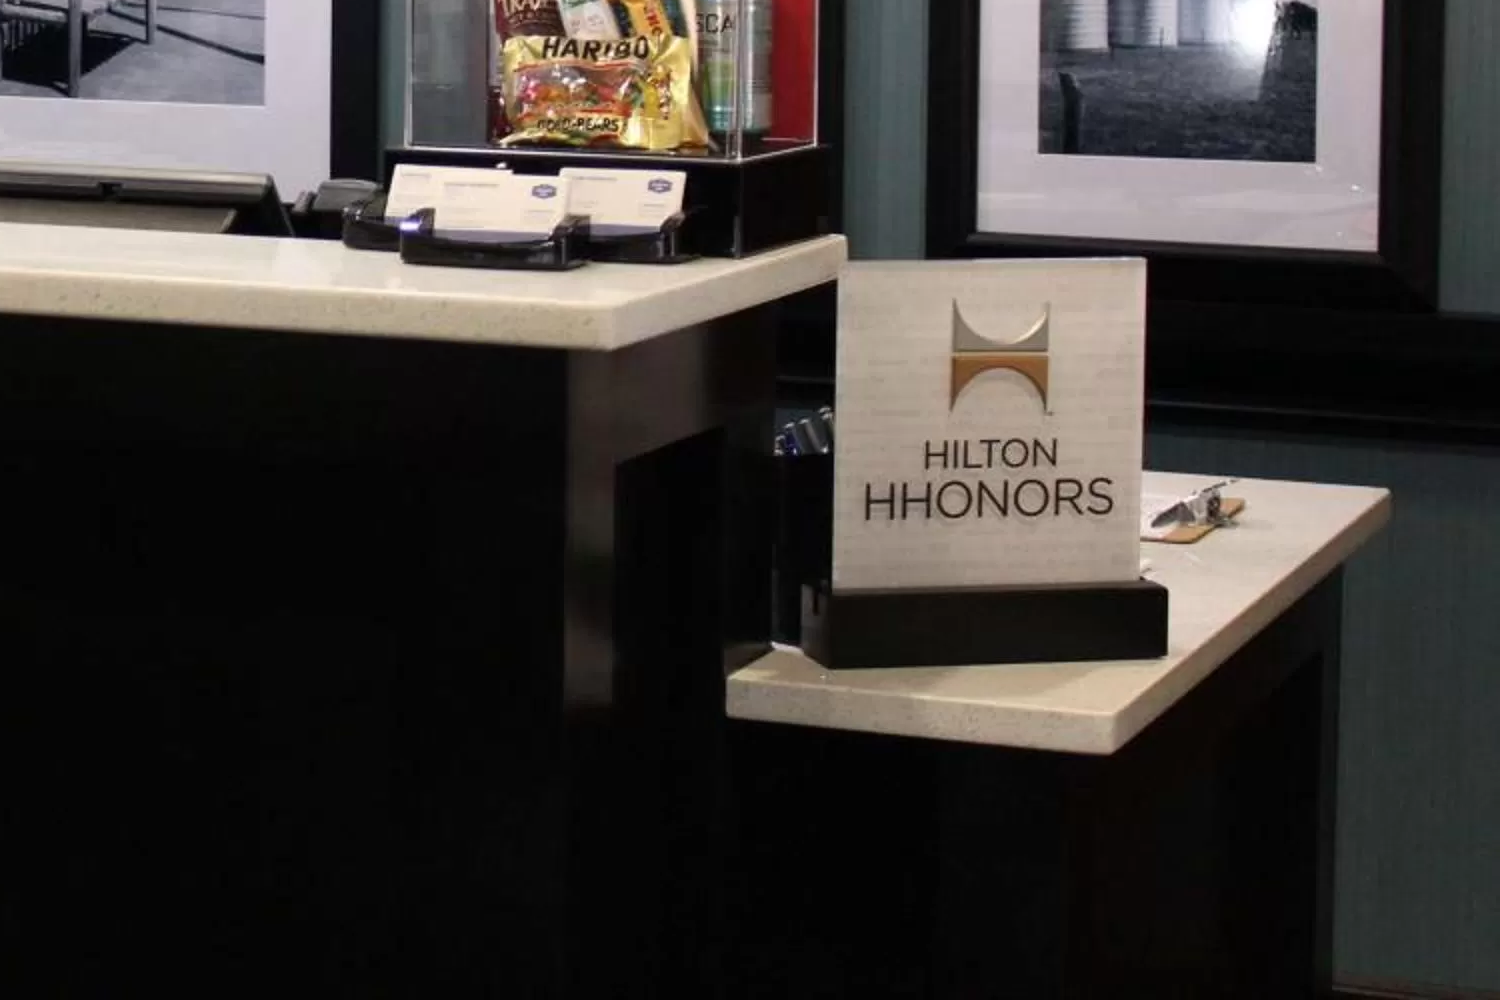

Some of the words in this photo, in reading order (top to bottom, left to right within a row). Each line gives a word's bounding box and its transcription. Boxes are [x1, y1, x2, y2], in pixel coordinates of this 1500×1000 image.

[542, 36, 649, 61] HARIBO
[923, 438, 1059, 471] HILTON
[864, 477, 1114, 521] HHONORS
